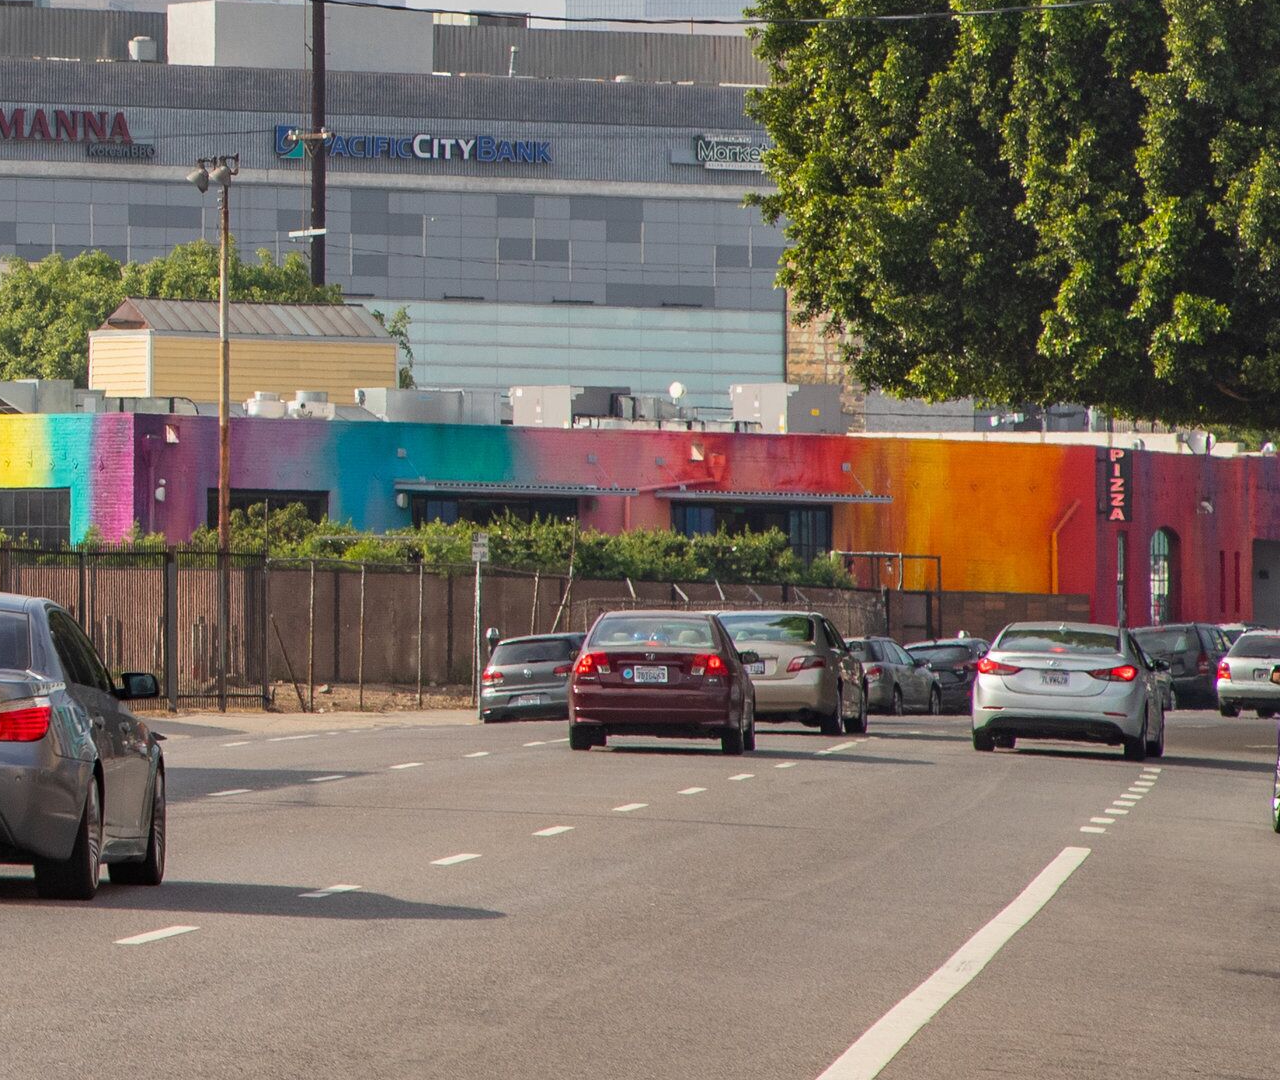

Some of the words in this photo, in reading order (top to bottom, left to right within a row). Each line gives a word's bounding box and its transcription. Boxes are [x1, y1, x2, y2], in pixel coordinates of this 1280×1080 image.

[413, 134, 476, 160] CITY
[476, 135, 554, 163] BANK
[1109, 449, 1125, 520] PIZZA
